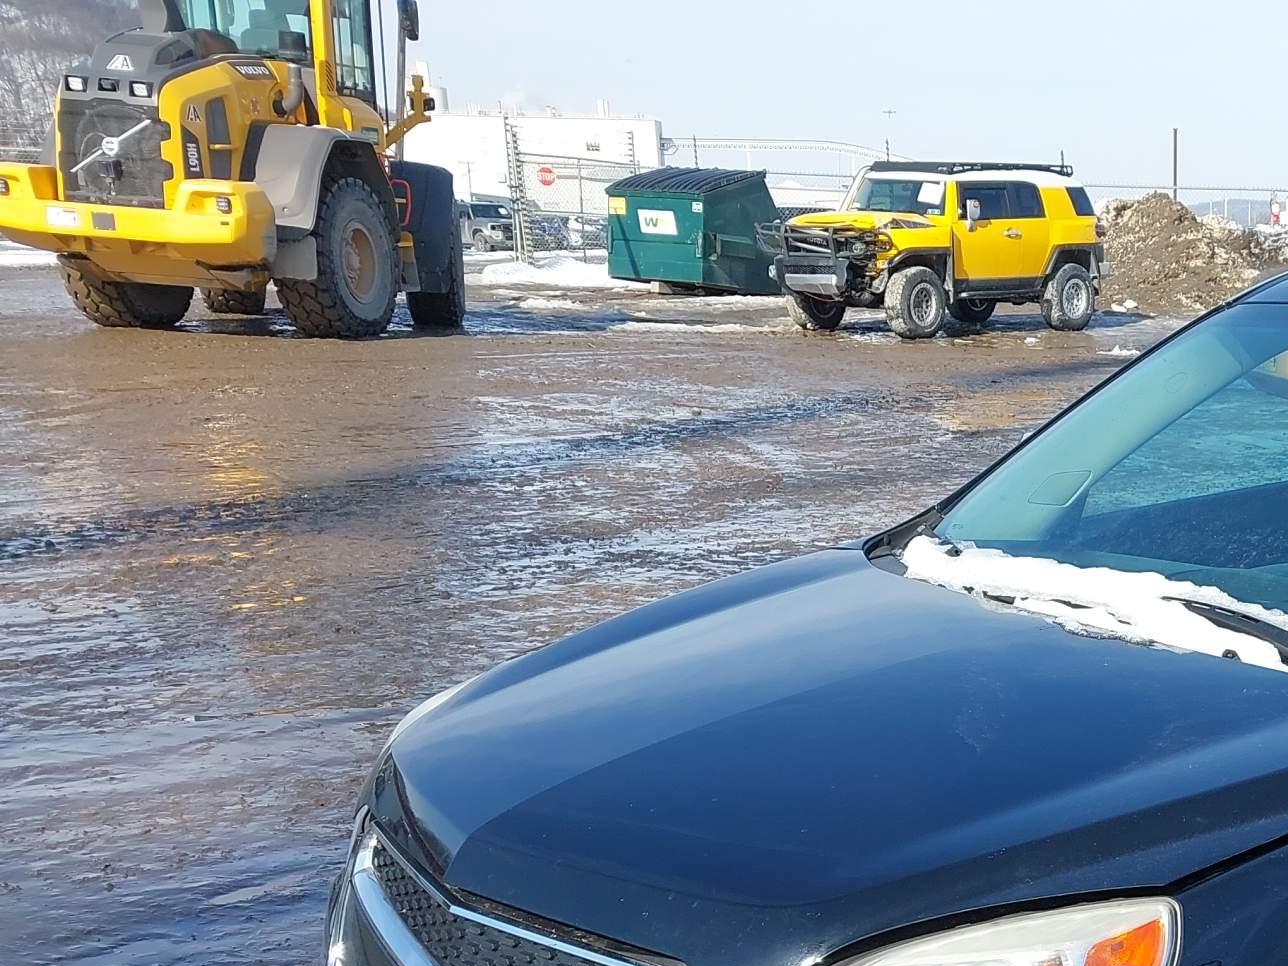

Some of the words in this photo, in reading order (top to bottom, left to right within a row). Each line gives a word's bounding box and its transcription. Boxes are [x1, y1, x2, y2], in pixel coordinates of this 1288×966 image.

[235, 64, 270, 75] VOLVO
[186, 142, 201, 172] L90H
[537, 171, 556, 181] STOP
